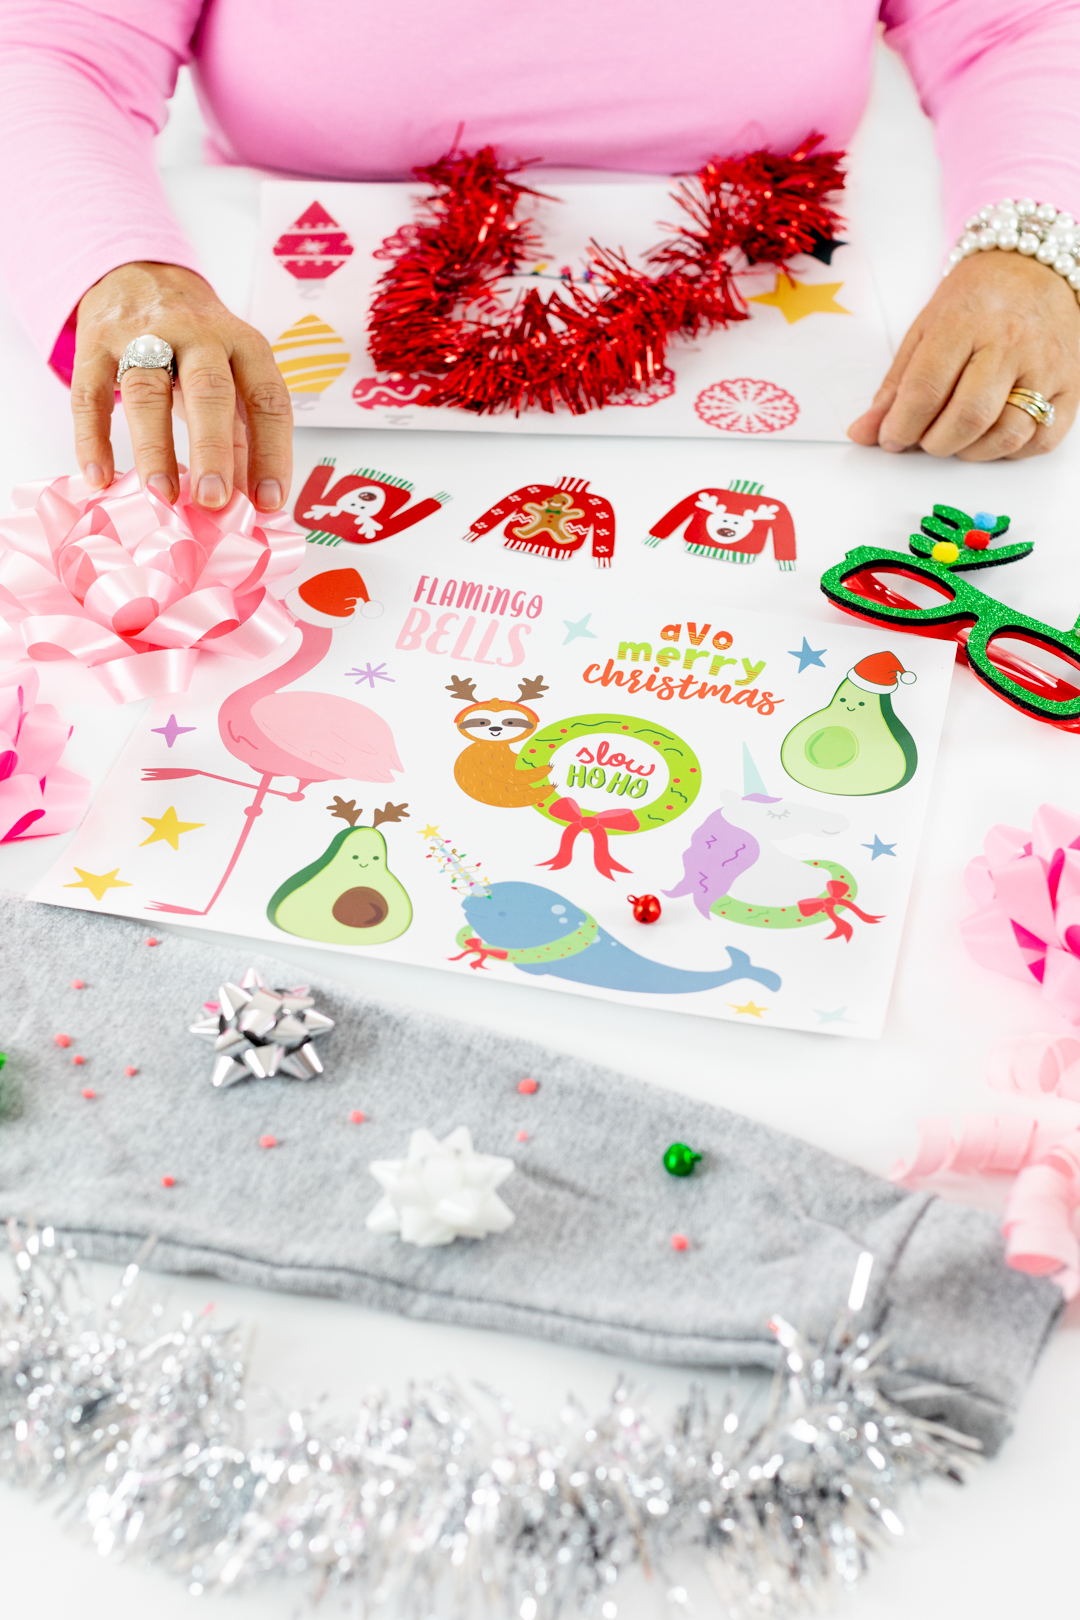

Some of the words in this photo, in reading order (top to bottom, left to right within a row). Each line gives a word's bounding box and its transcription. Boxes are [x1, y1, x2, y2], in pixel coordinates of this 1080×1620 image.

[395, 607, 532, 668] BELLS
[582, 658, 785, 716] christmas
[617, 641, 767, 687] merry
[575, 740, 656, 777] slow
